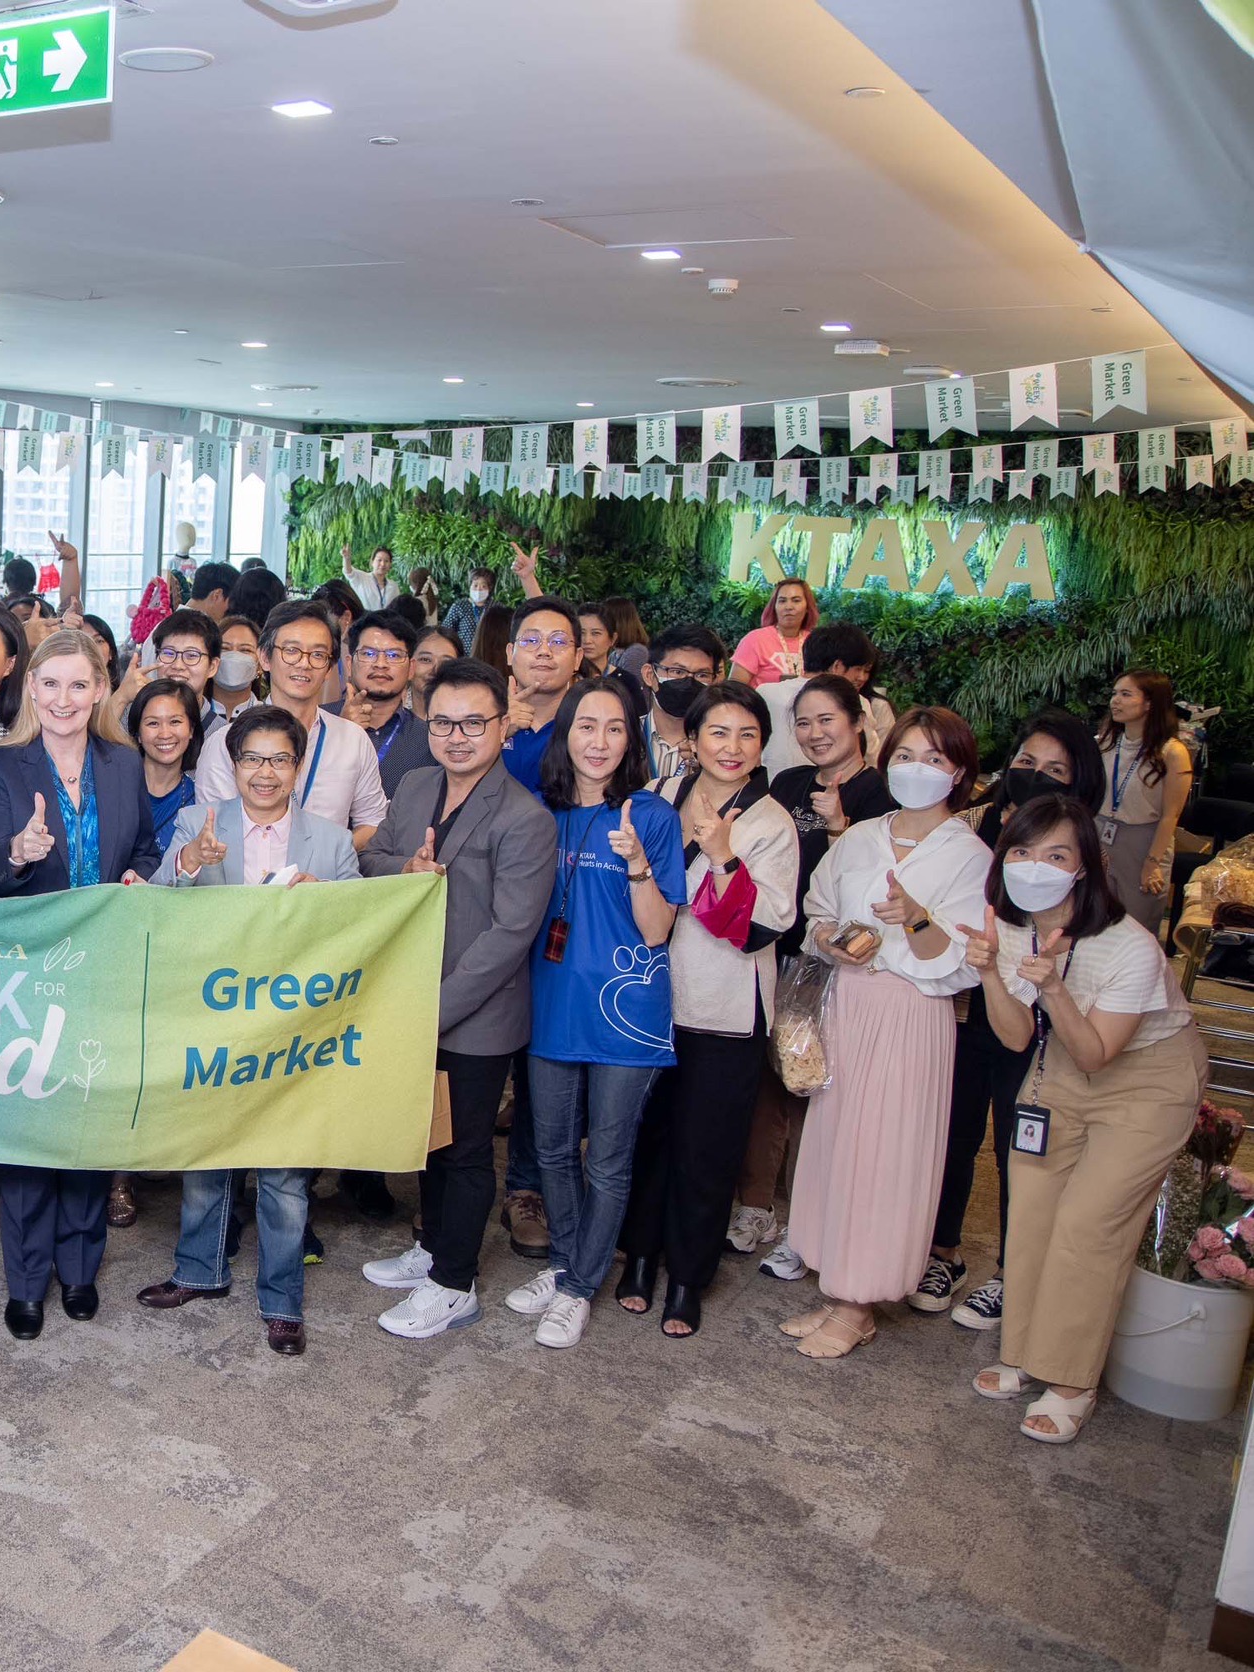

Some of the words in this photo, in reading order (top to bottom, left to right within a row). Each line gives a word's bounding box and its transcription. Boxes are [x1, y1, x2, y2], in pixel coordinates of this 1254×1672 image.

[1104, 362, 1117, 401] Market
[1121, 362, 1132, 395] Green
[937, 387, 949, 423] Market
[953, 388, 962, 418] Green
[646, 418, 654, 451] Market
[658, 419, 666, 448] Green
[785, 406, 795, 441] Market
[799, 406, 807, 436] Green
[305, 443, 313, 468] Green
[520, 430, 528, 462] Market
[531, 432, 540, 459] Green
[1158, 434, 1166, 456] Green
[729, 513, 1055, 600] KTAXA
[603, 862, 625, 873] Action
[34, 981, 65, 997] FOR
[202, 967, 363, 1011] Green
[182, 1024, 362, 1090] Market
